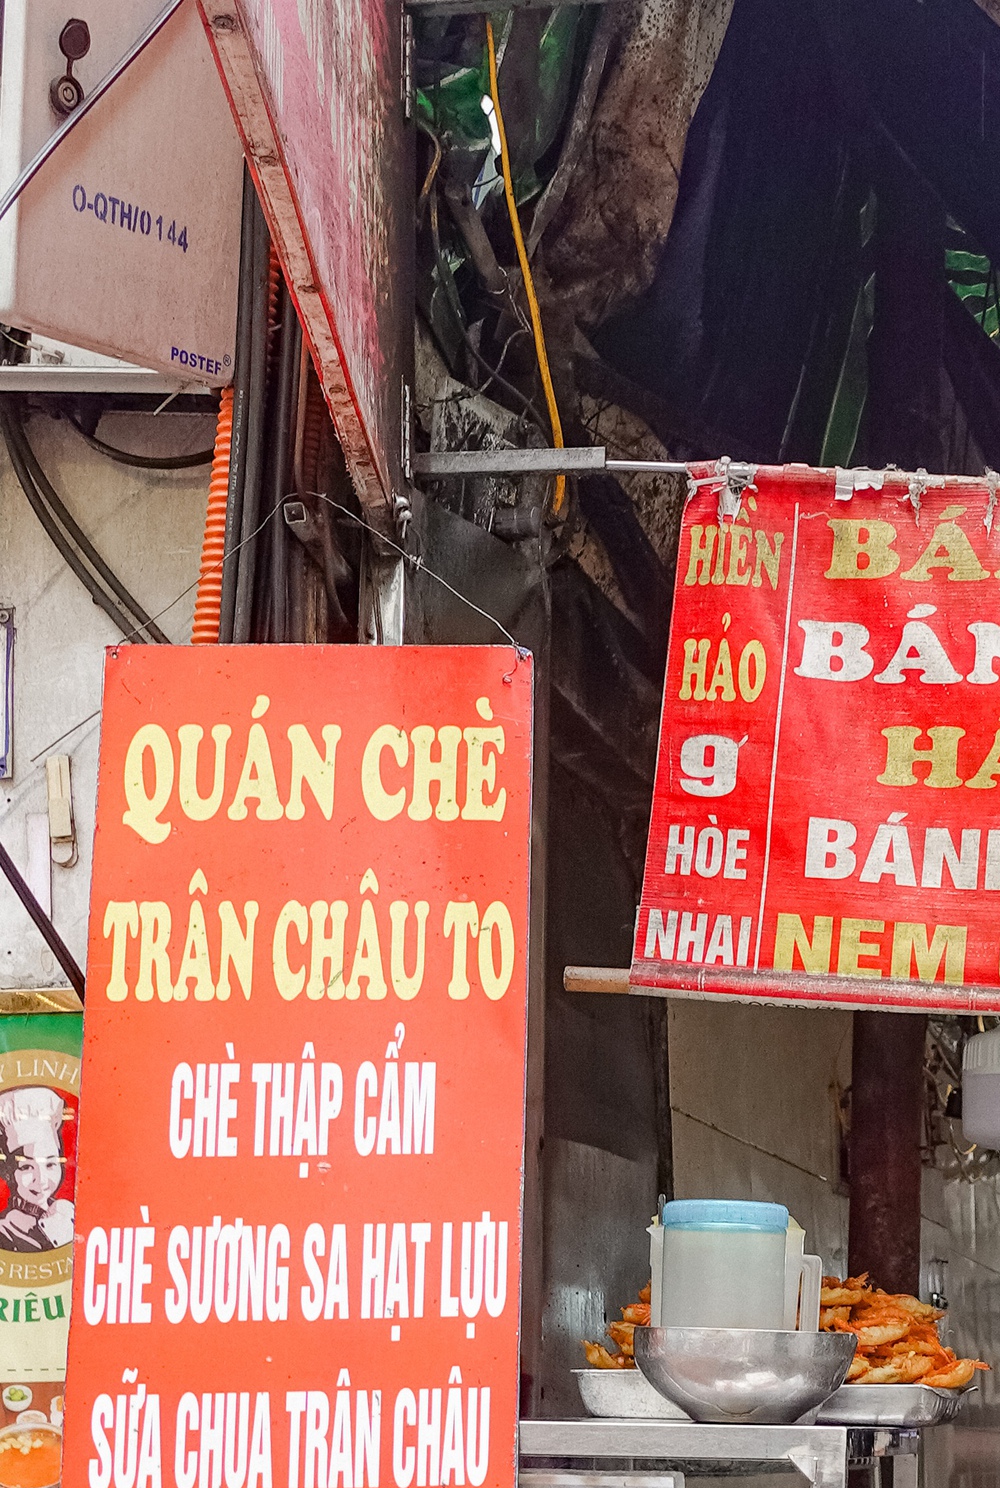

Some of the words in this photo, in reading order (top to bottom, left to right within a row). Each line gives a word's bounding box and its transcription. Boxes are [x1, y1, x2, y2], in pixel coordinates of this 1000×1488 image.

[683, 496, 784, 590] HIỀN
[679, 612, 767, 703] HẢO
[122, 695, 342, 844] QUÁN
[361, 697, 506, 822] CHÈ
[665, 815, 750, 881] HÒE
[103, 868, 259, 1003] TRÂN
[272, 868, 430, 1002] CHÂU
[443, 900, 515, 1001] TO
[644, 909, 752, 968] NHAI
[774, 912, 969, 989] NEM
[16, 1058, 79, 1085] LINH
[169, 1042, 240, 1159] CHÈ
[252, 1042, 343, 1178] THẬP
[354, 1022, 437, 1157] CẨM
[84, 1205, 155, 1326] CHÈ
[165, 1217, 291, 1324] SƯƠNG
[301, 1223, 349, 1322] SA
[361, 1222, 431, 1341] HẠT
[440, 1211, 509, 1339] LỰU
